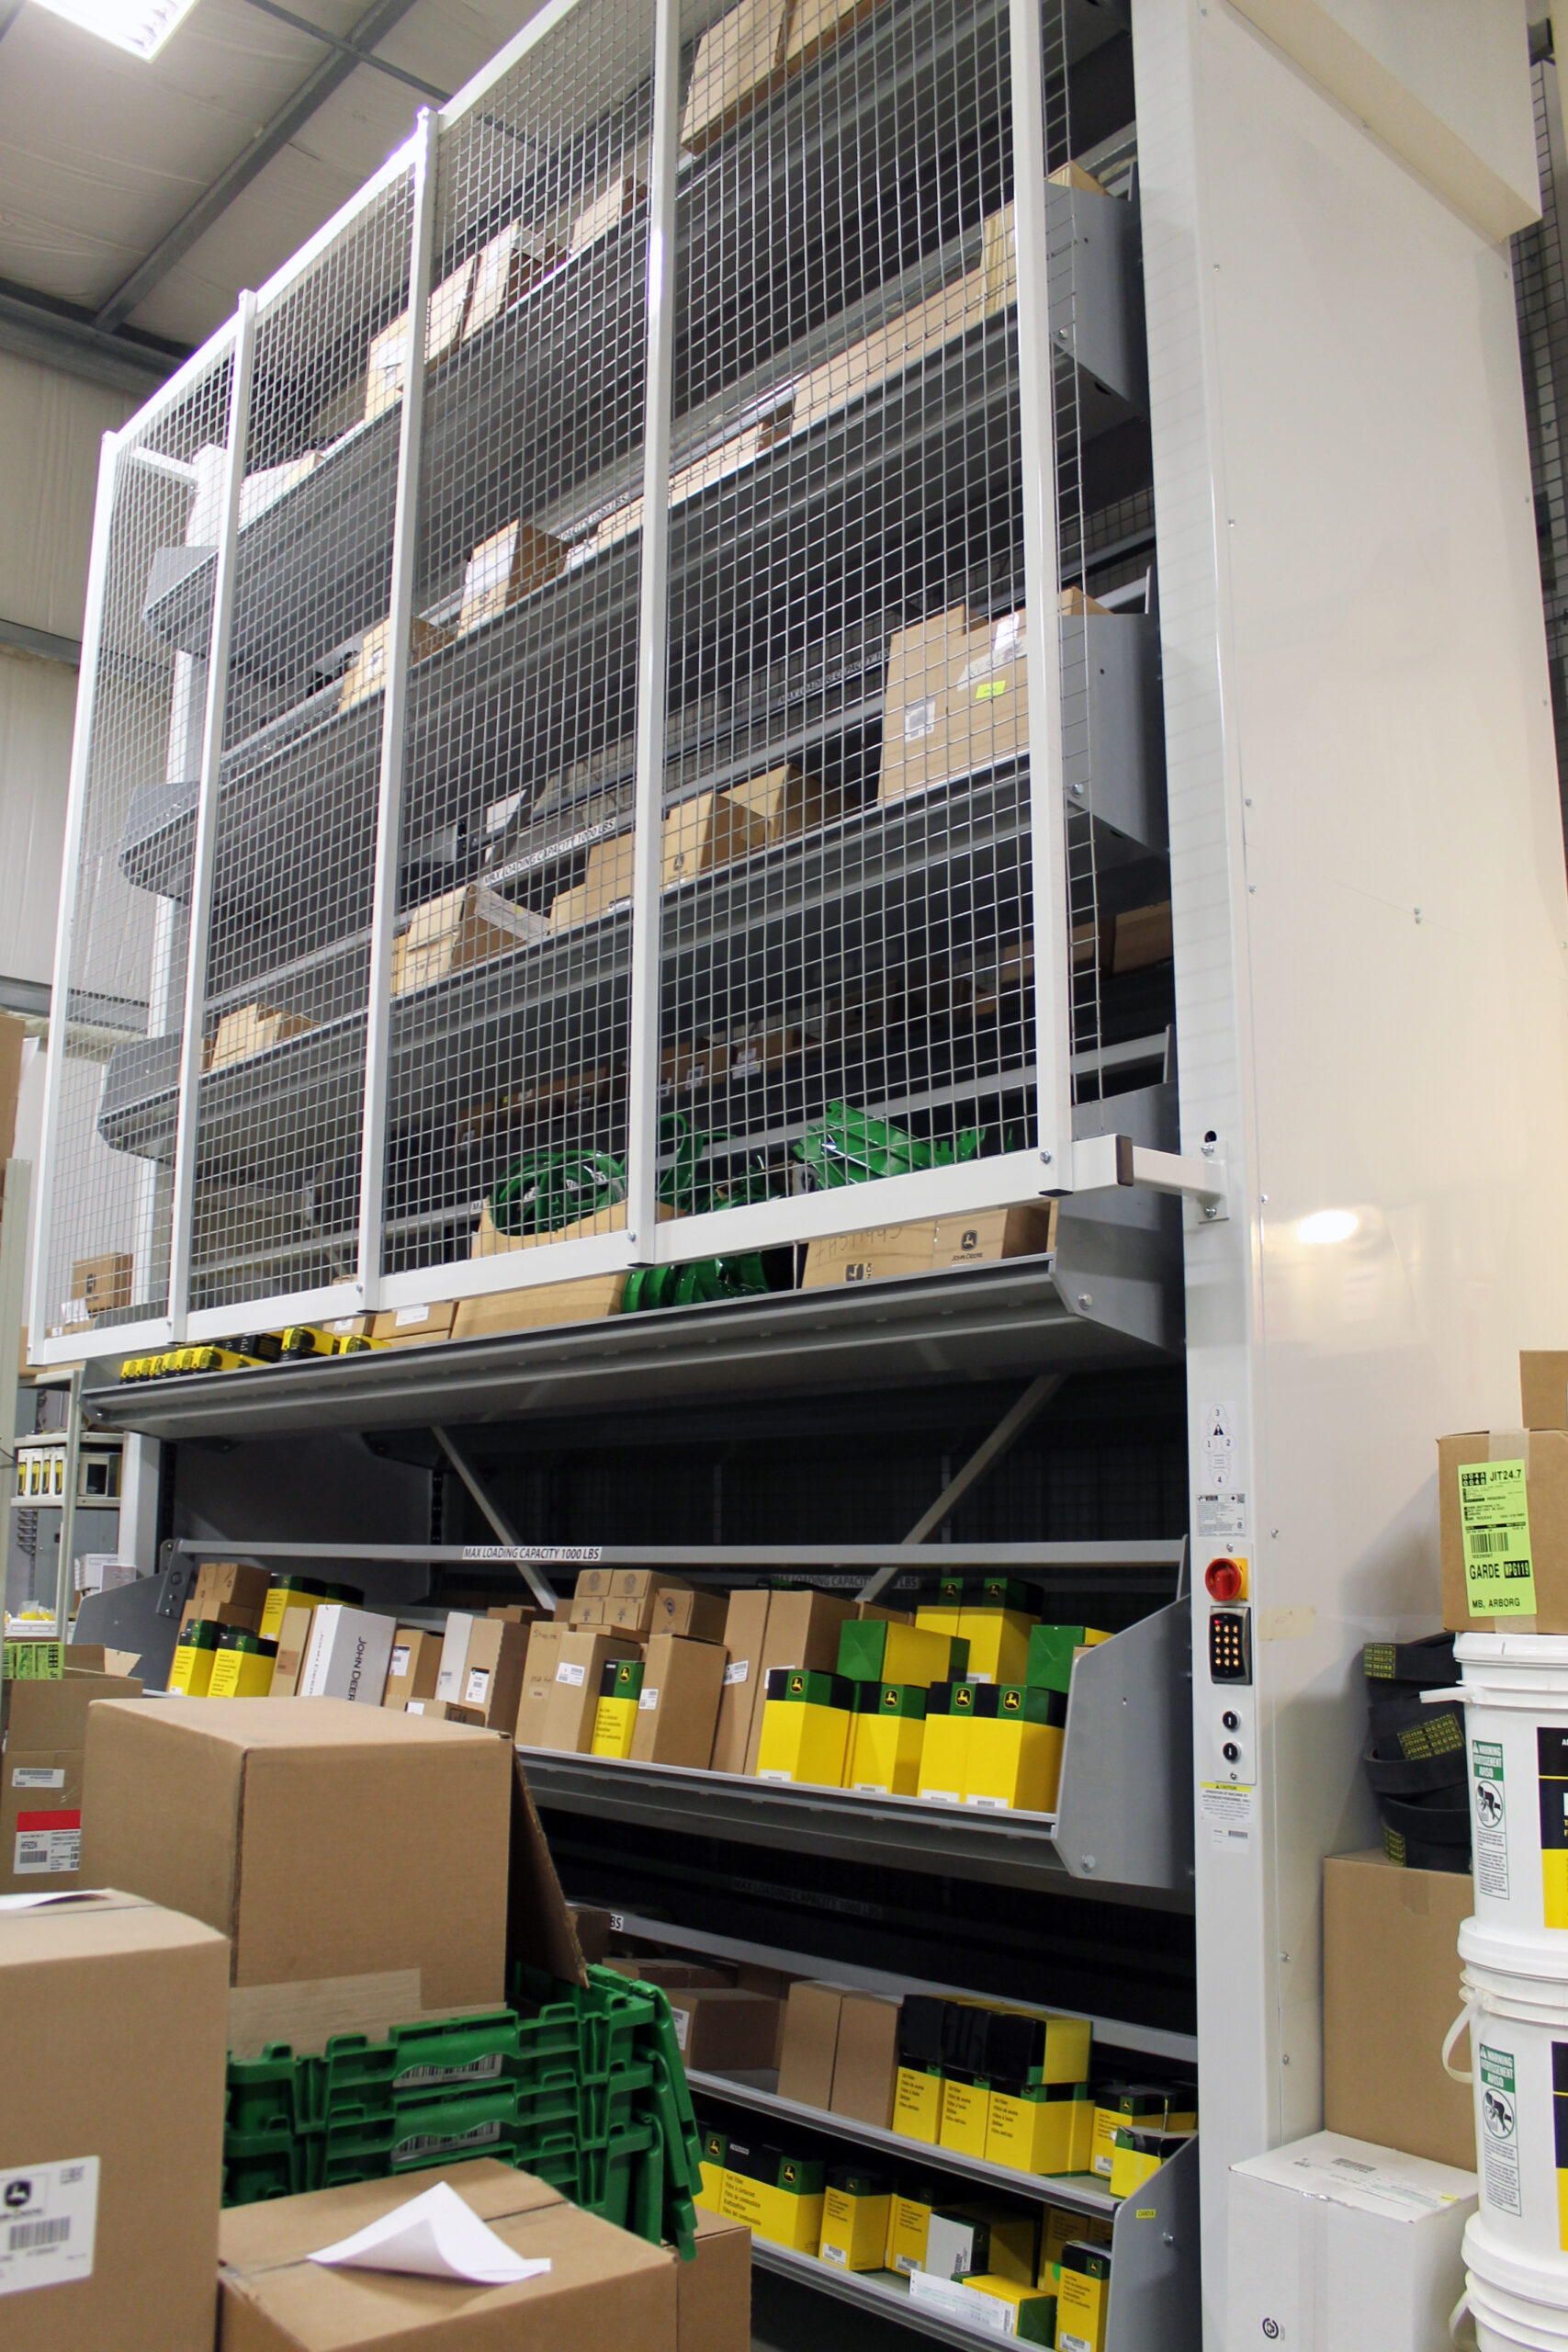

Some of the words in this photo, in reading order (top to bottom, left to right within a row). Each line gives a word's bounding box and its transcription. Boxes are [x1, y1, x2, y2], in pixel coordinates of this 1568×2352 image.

[504, 854, 536, 876] LOADING
[536, 836, 577, 862] CAPACITY
[577, 829, 596, 845] 1000
[598, 820, 615, 834] LBS
[1489, 1469, 1522, 1482] JIT24.7
[464, 1546, 481, 1557] MAX
[482, 1547, 518, 1558] LOADING
[519, 1548, 560, 1559] CAPACITY
[561, 1548, 581, 1559] 1000
[583, 1548, 600, 1560] LBS
[1470, 1563, 1501, 1580] GARDE
[1472, 1600, 1486, 1609] MB,
[1488, 1597, 1520, 1609] ARBORG
[353, 1636, 367, 1669] JOHN
[347, 1671, 361, 1702] DEER
[610, 1916, 621, 1928] BS
